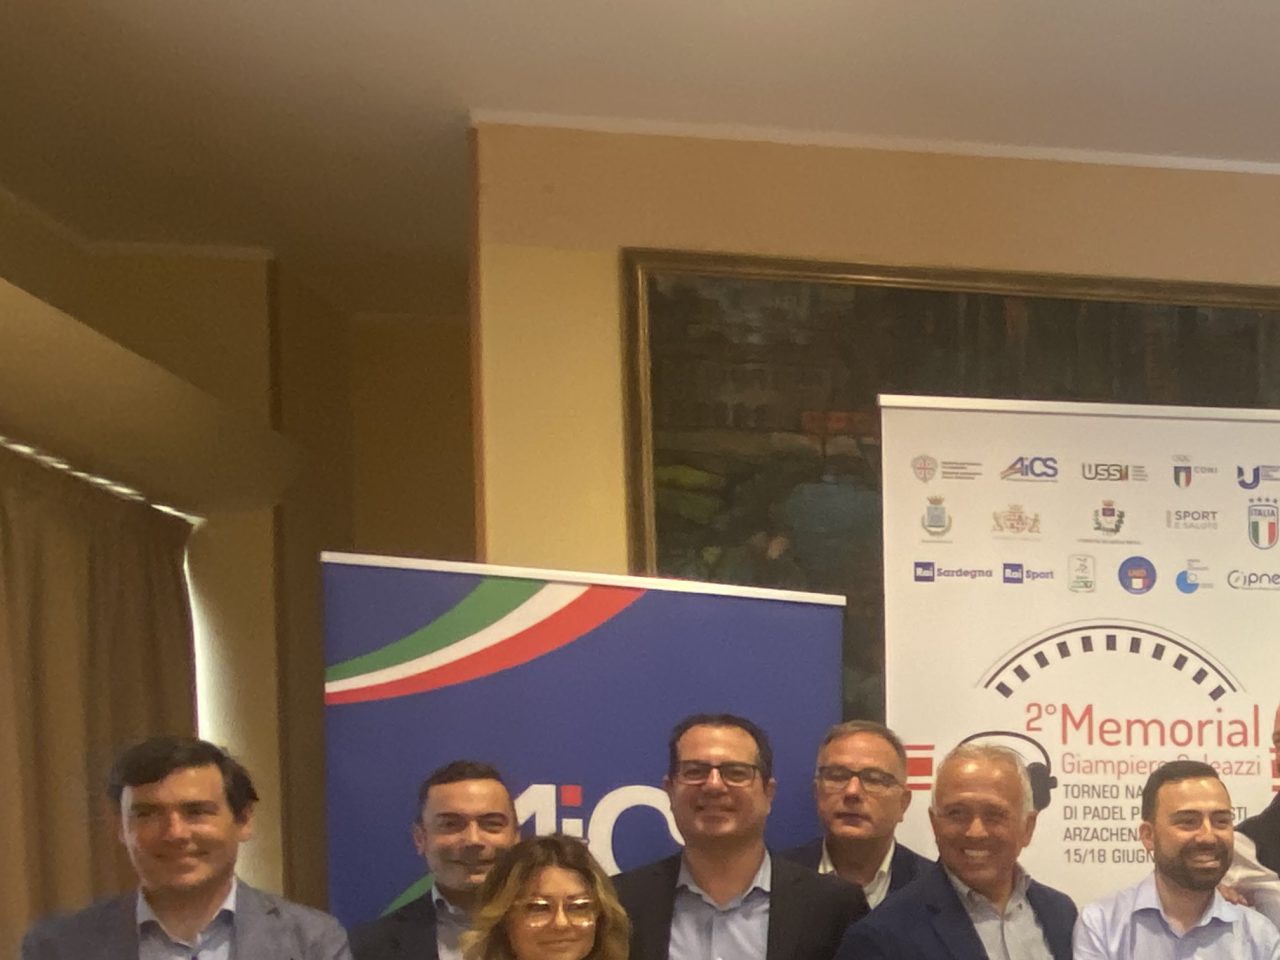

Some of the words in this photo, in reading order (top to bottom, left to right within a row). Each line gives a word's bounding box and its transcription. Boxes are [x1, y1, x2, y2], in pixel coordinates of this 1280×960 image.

[1175, 511, 1219, 521] SPORT
[1250, 507, 1276, 518] ITALIA
[937, 568, 993, 579] Sardegna
[1025, 570, 1054, 581] Sport
[1060, 703, 1260, 748] Memorial
[1063, 784, 1120, 799] TORNEO
[1064, 806, 1078, 821] DI
[1083, 806, 1126, 821] PADEL
[1064, 848, 1107, 864] 15/18
